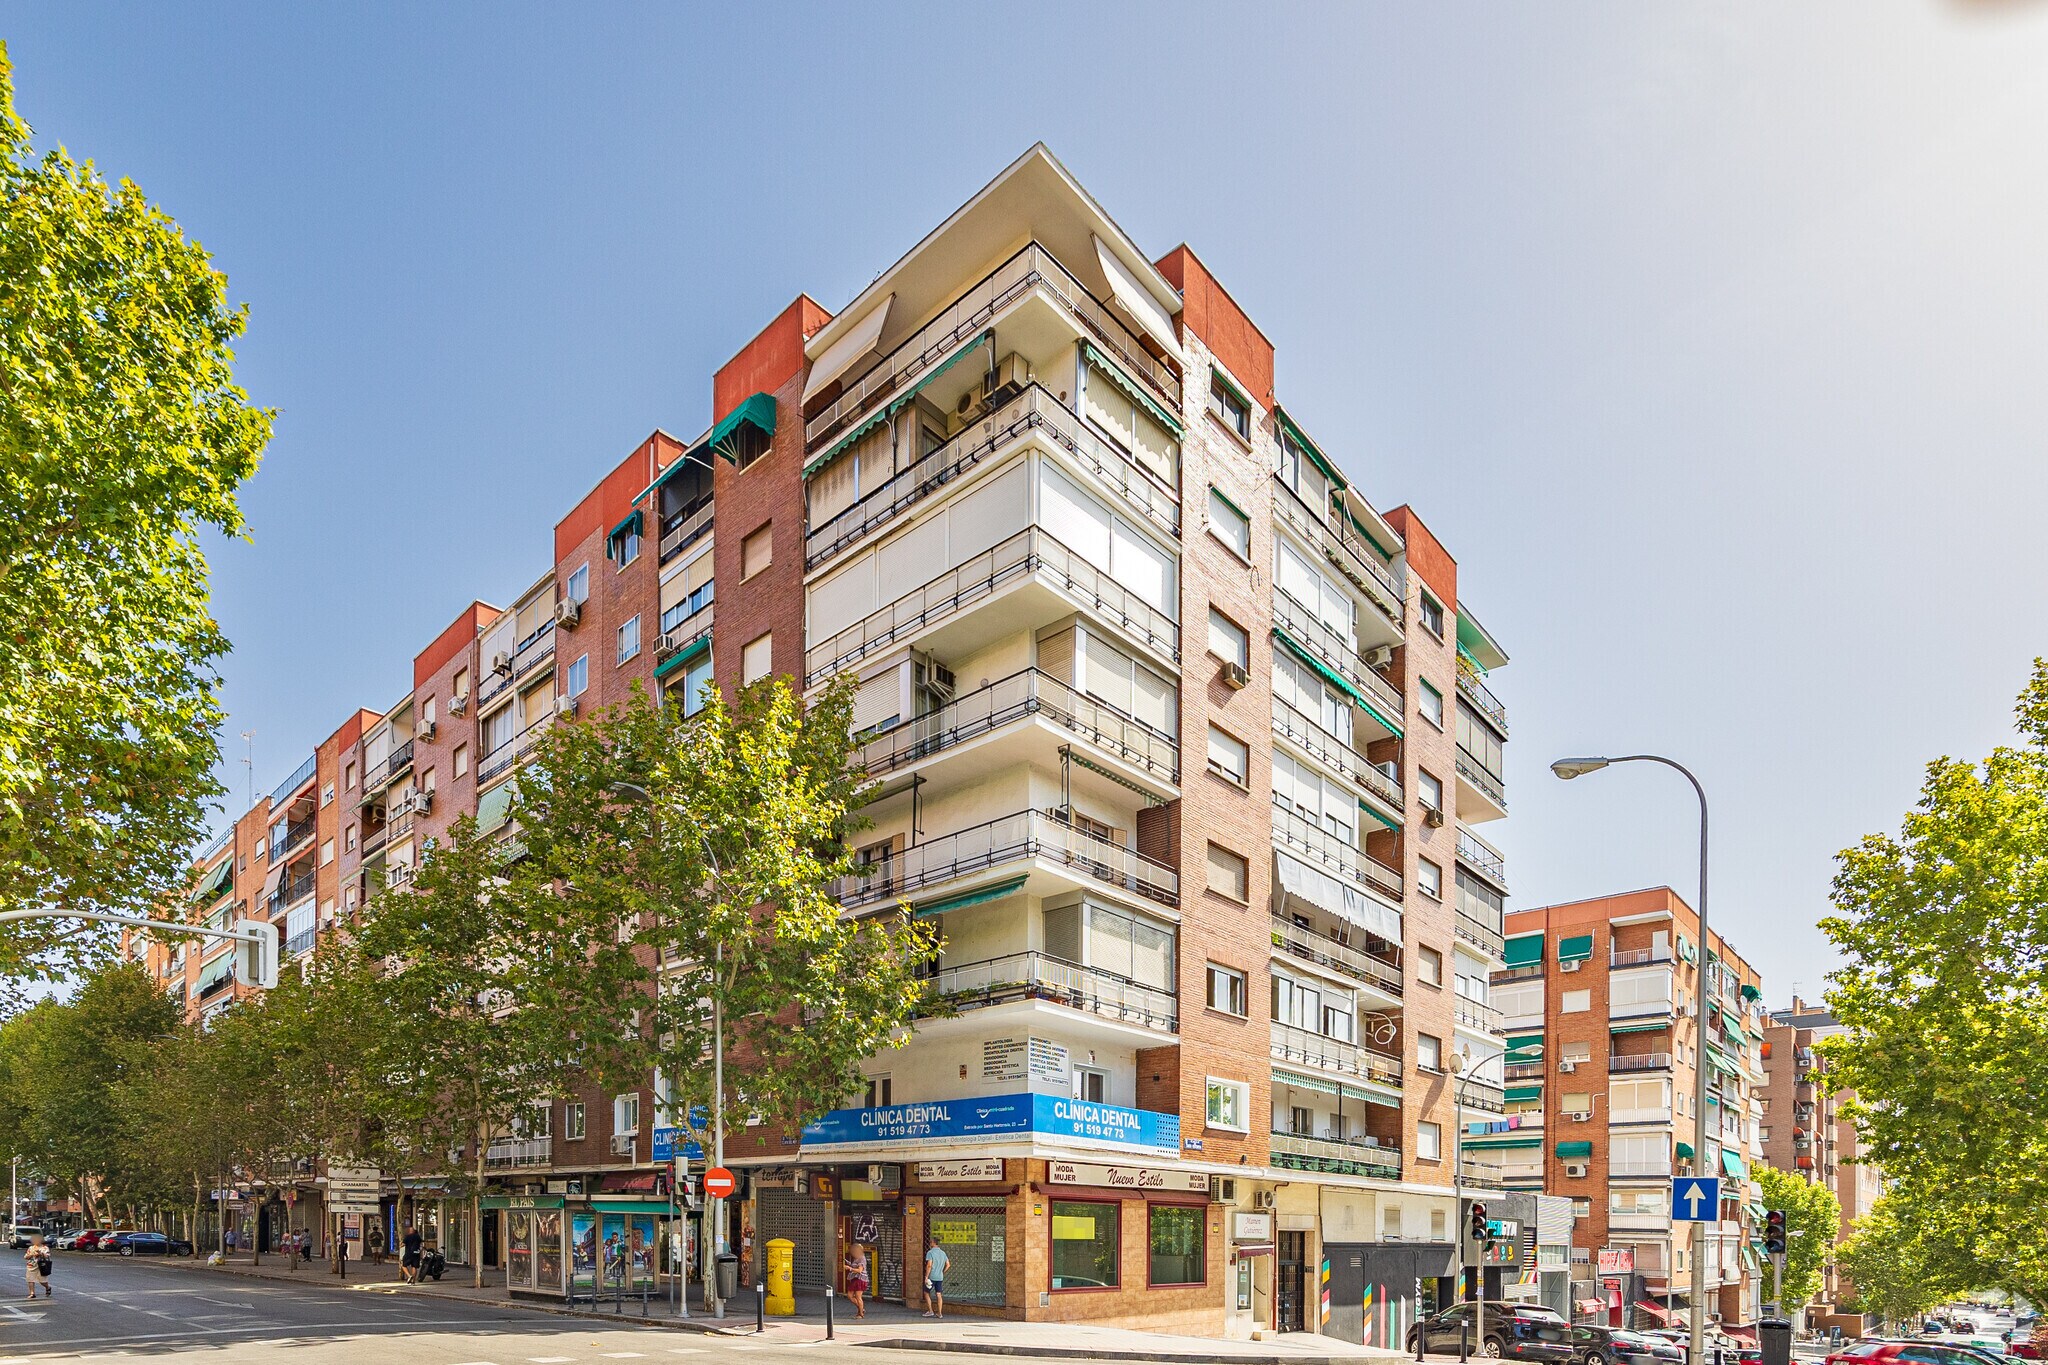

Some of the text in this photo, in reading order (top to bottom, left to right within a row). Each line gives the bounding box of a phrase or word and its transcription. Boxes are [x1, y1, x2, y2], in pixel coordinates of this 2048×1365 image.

[861, 1106, 951, 1126] CLÍNICA DENTAL
[1054, 1100, 1141, 1130] CLÍNICA DENTAL
[878, 1124, 930, 1136] 91 519 47 73
[1074, 1122, 1124, 1139] 91 519 47 73
[937, 1165, 982, 1177] Nuevo Estilo
[1056, 1165, 1074, 1173] MODA
[1054, 1174, 1076, 1182] MUJER
[1107, 1168, 1164, 1187] Nuevo Estilo
[510, 1198, 519, 1207] EL
